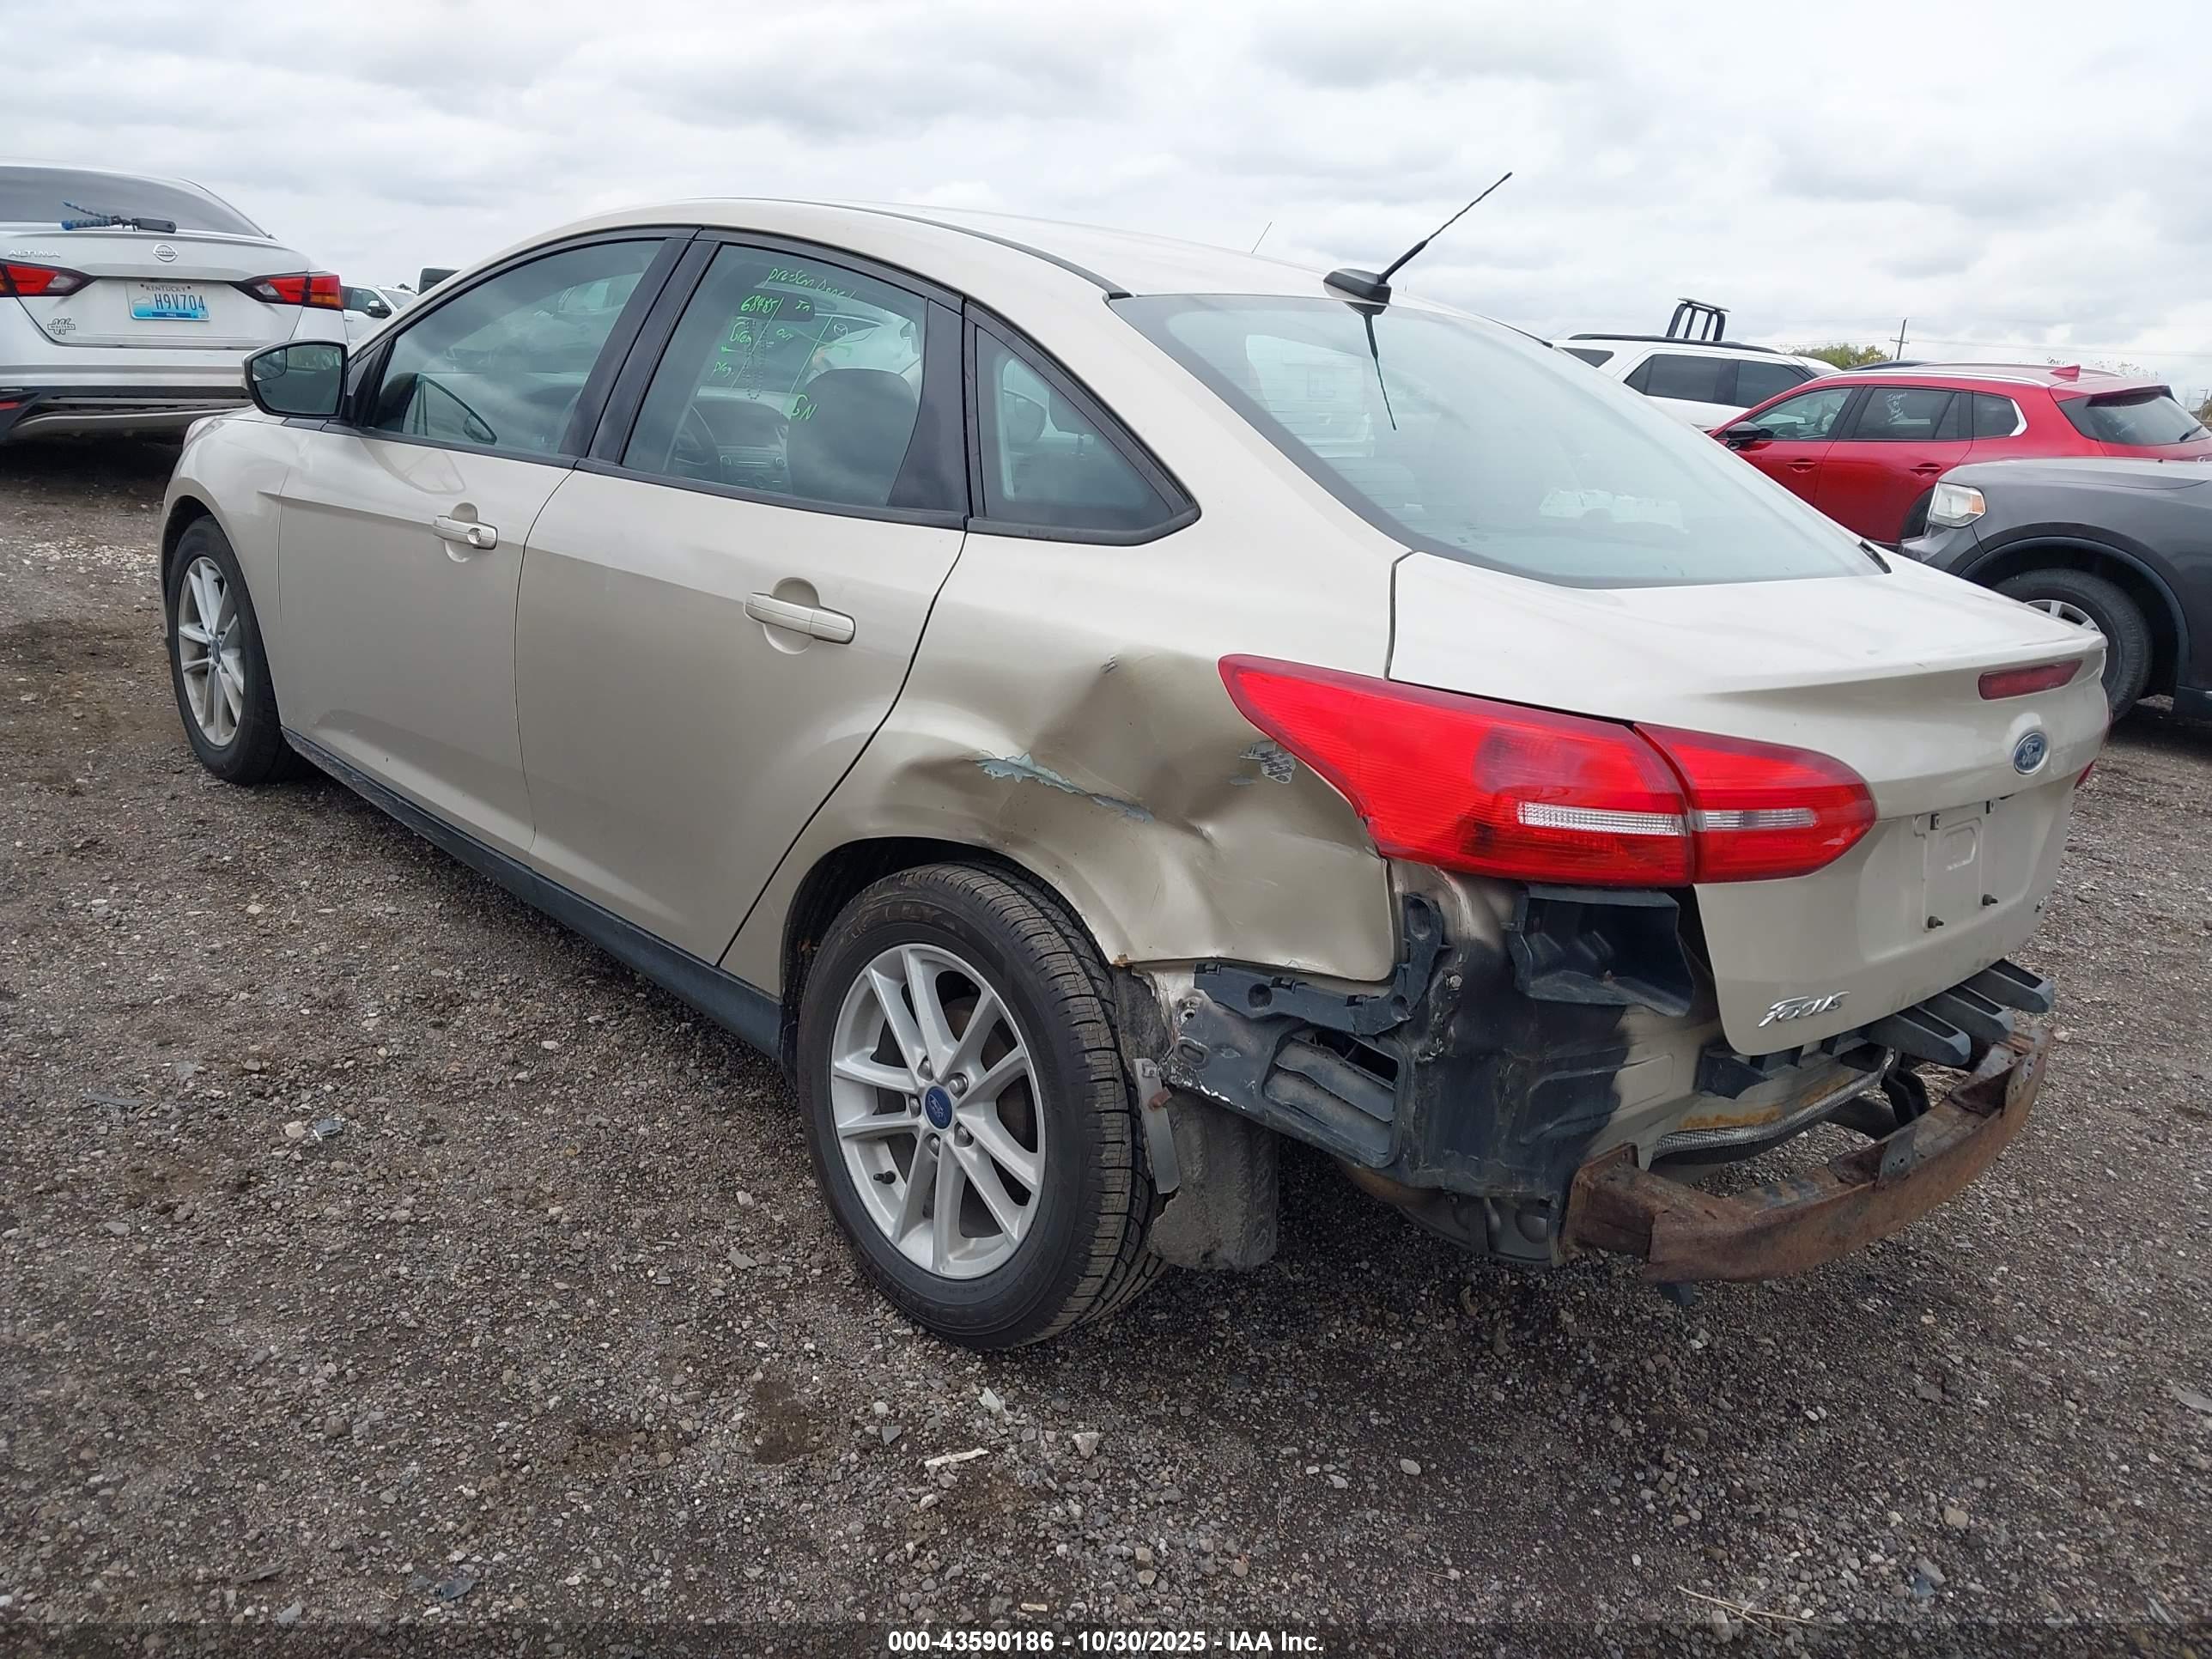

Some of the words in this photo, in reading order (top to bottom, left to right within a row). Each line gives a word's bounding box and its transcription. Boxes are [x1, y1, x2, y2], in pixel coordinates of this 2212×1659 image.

[8, 249, 61, 258] ALTIMA
[154, 293, 206, 311] H9V704
[1758, 990, 1850, 1028] Focus
